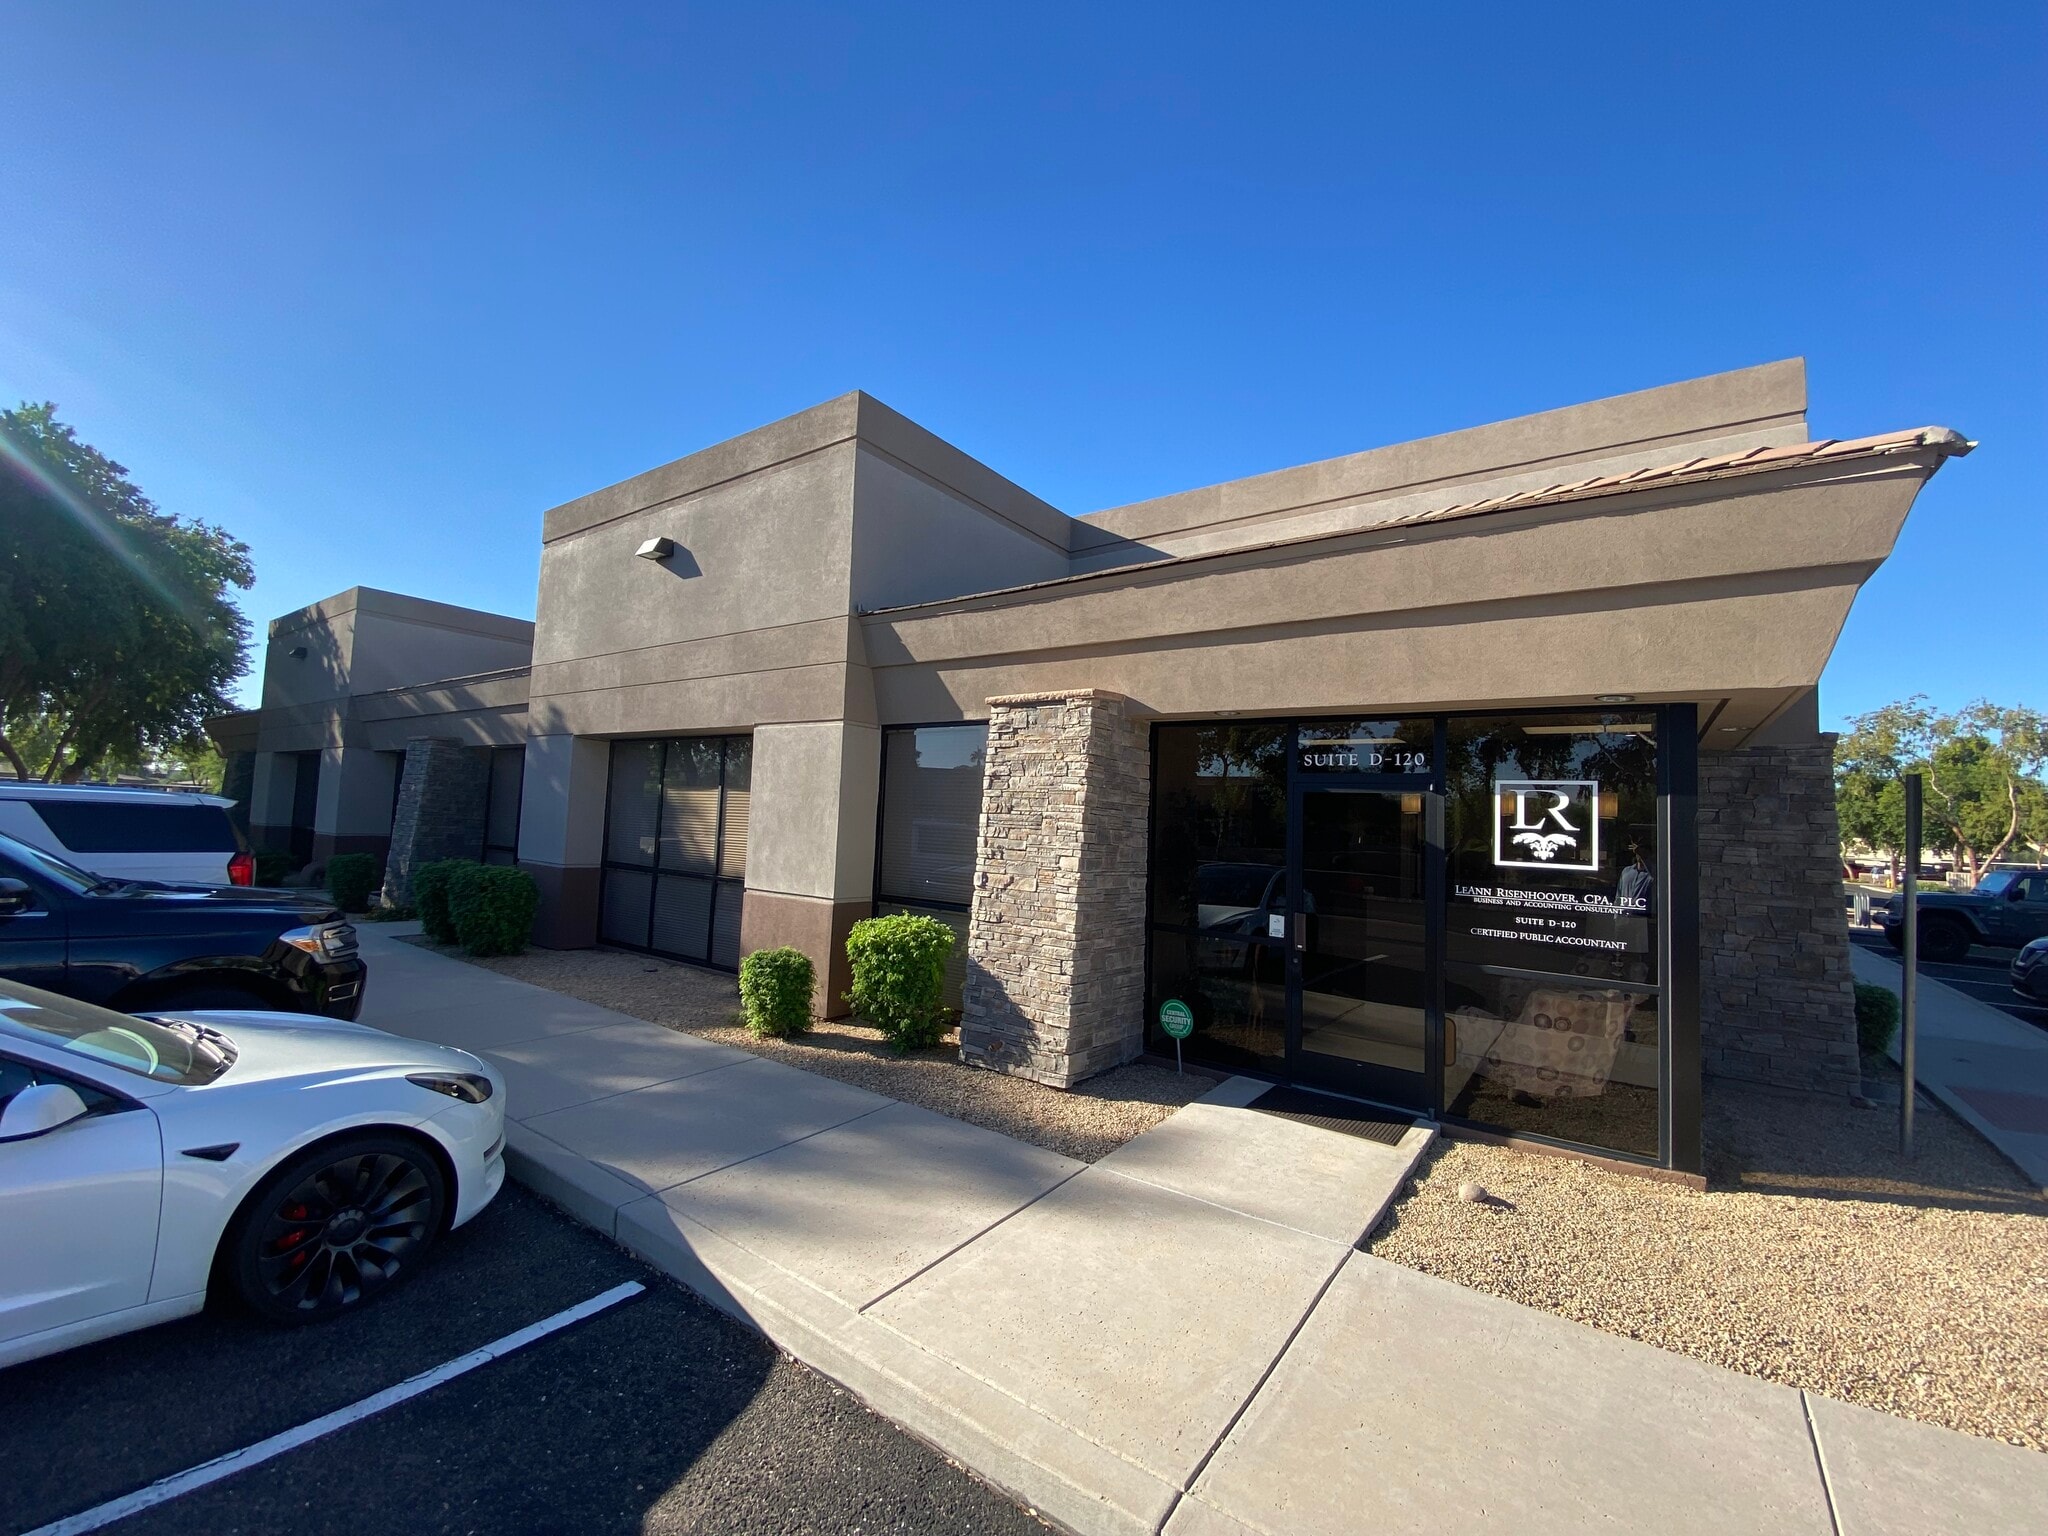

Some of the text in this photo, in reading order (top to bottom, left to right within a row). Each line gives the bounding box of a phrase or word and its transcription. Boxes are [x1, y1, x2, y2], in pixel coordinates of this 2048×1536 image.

[1303, 753, 1425, 767] SUITE D-120
[1473, 897, 1504, 905] BUSINESS
[1523, 901, 1572, 911] ACCOUNTING
[1583, 894, 1613, 907] CPA,
[1620, 896, 1647, 908] PLC
[1515, 917, 1577, 929] SUITE D-120
[1470, 927, 1627, 950] CERTIFIED PUBLIC ACCOUNTANT
[1161, 1015, 1191, 1025] SECURITY
